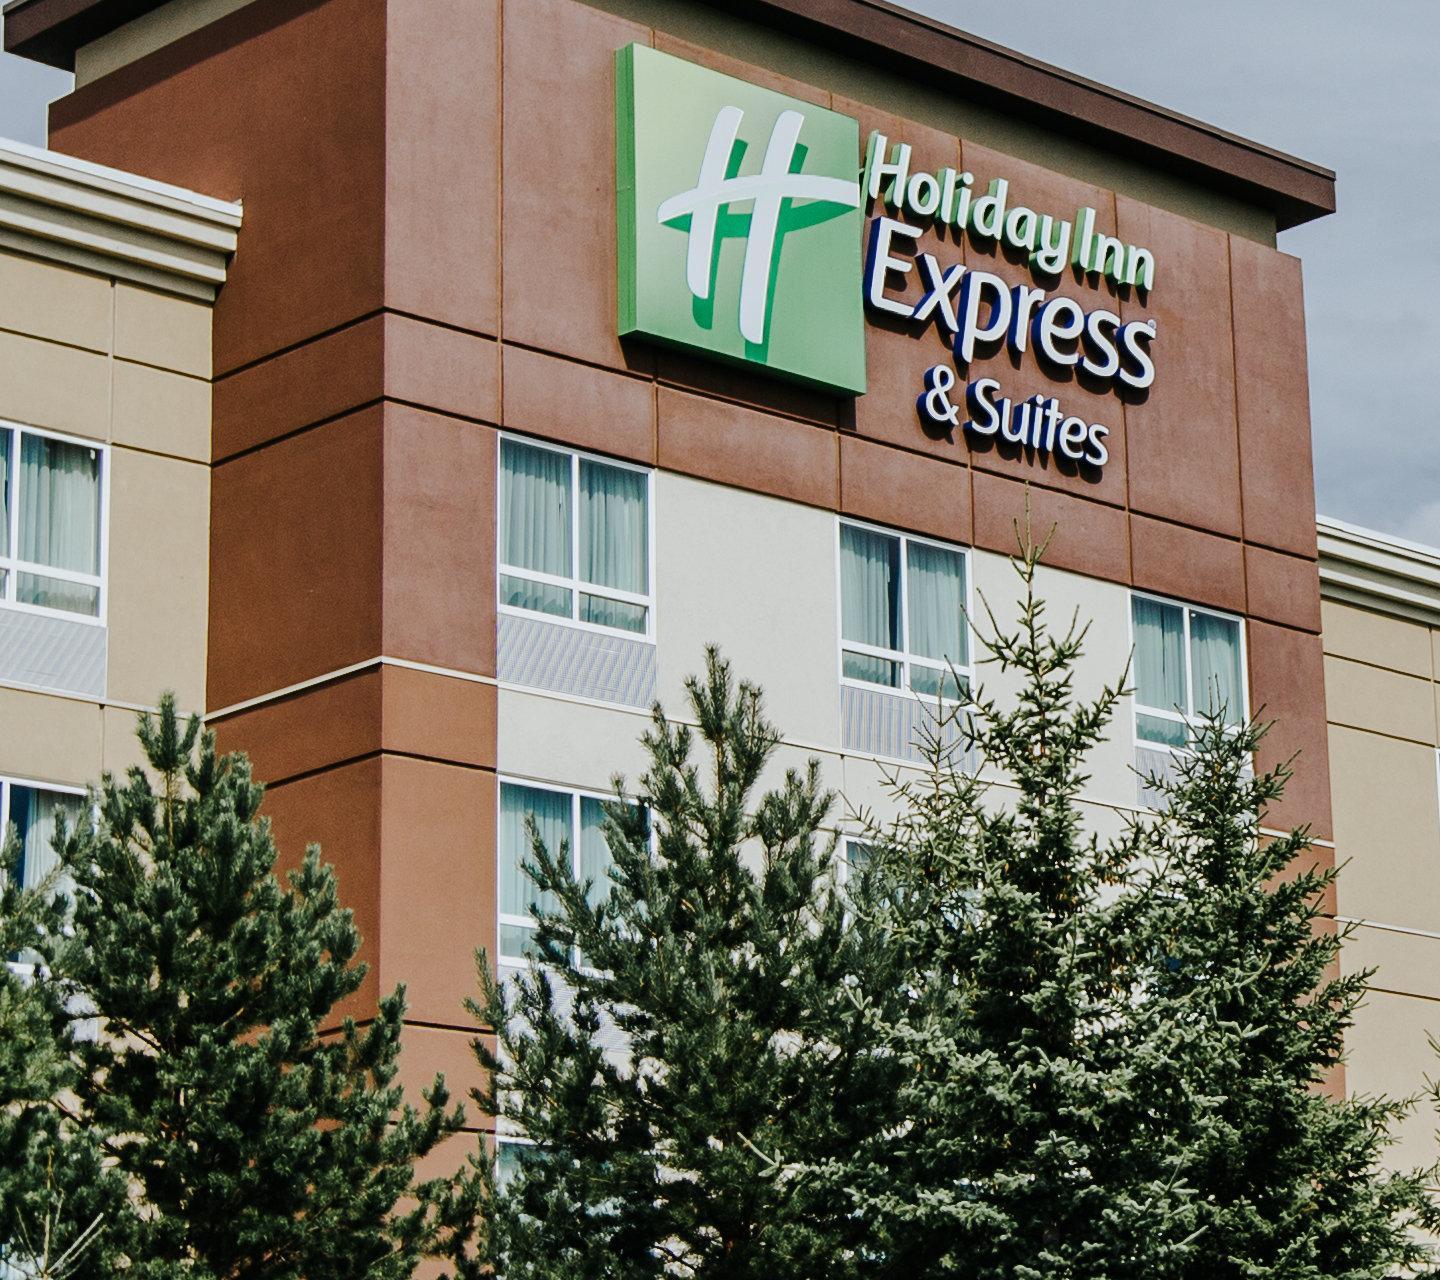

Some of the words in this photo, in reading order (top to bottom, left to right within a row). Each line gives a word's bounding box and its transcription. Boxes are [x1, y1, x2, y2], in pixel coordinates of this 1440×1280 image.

[864, 131, 1071, 275] Holiday
[1075, 207, 1156, 292] Inn
[867, 216, 1157, 388] Express
[922, 364, 960, 426] &
[968, 378, 1110, 466] Suites
